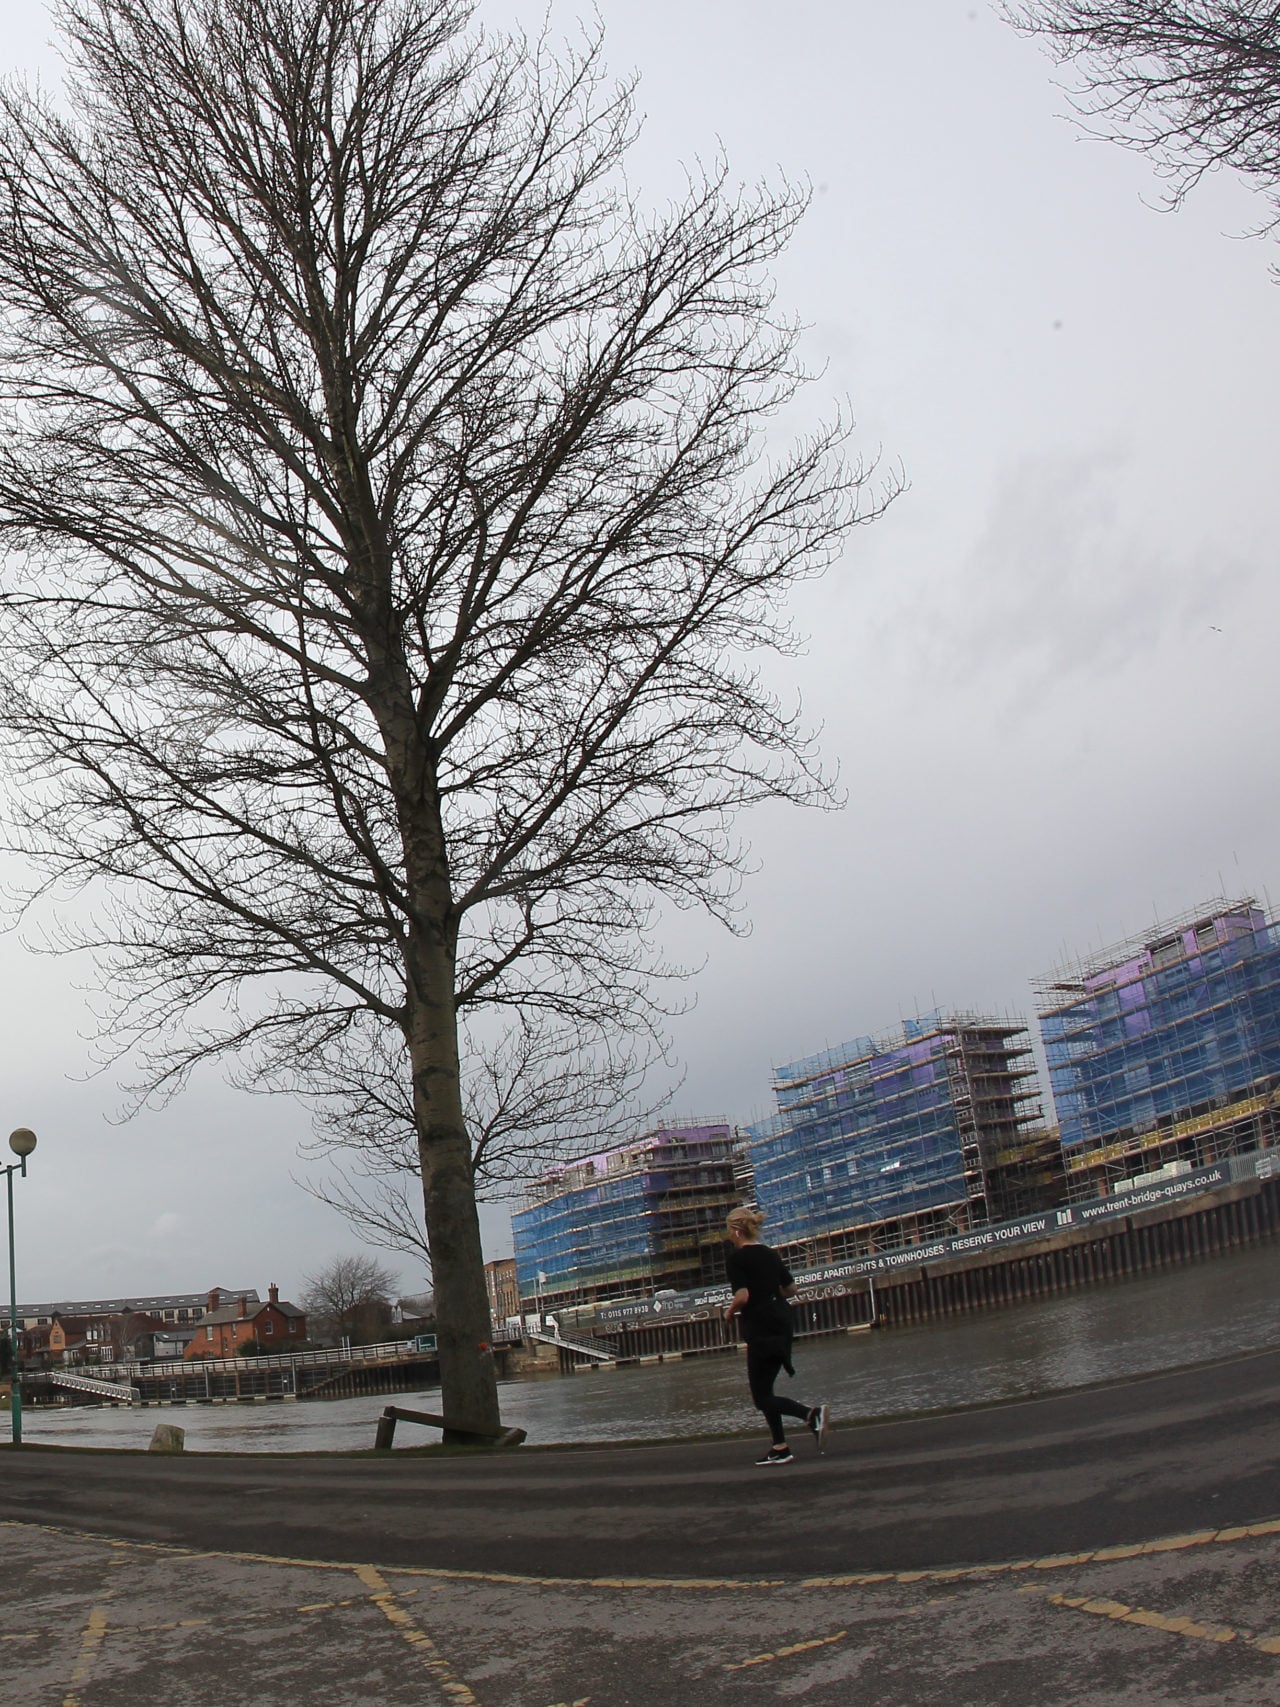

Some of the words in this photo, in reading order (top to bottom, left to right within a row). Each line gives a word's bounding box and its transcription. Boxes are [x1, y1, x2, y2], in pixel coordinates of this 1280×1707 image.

[1081, 1169, 1222, 1219] www.trent-bridge-quays.co.uk
[794, 1271, 823, 1285] ERSIDE
[823, 1260, 877, 1279] APARTMENTS
[878, 1258, 885, 1268] &
[885, 1244, 945, 1267] TOWNHOUSES
[951, 1232, 993, 1252] RESERVE
[994, 1225, 1021, 1241] YOUR
[1021, 1219, 1045, 1234] VIEW
